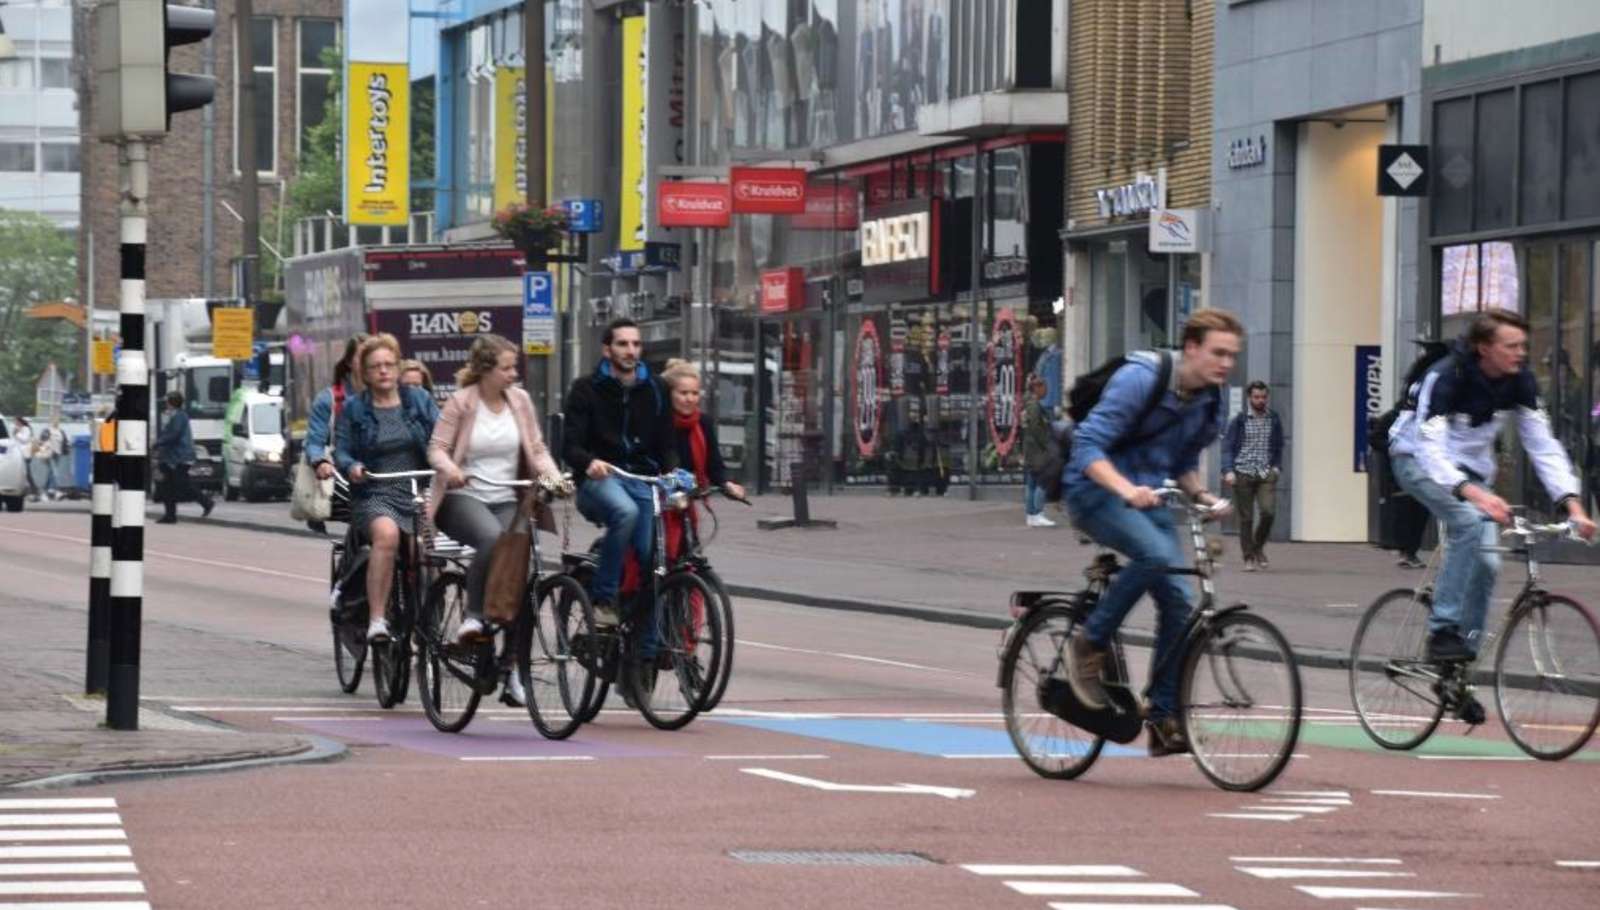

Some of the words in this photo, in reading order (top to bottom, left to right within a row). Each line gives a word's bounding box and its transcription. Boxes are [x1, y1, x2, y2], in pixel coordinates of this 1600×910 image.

[363, 72, 393, 192] Intertoys
[751, 181, 799, 197] Kruidvat
[676, 197, 724, 211] Kruidvat
[531, 276, 547, 299] P
[409, 311, 493, 335] HANOS
